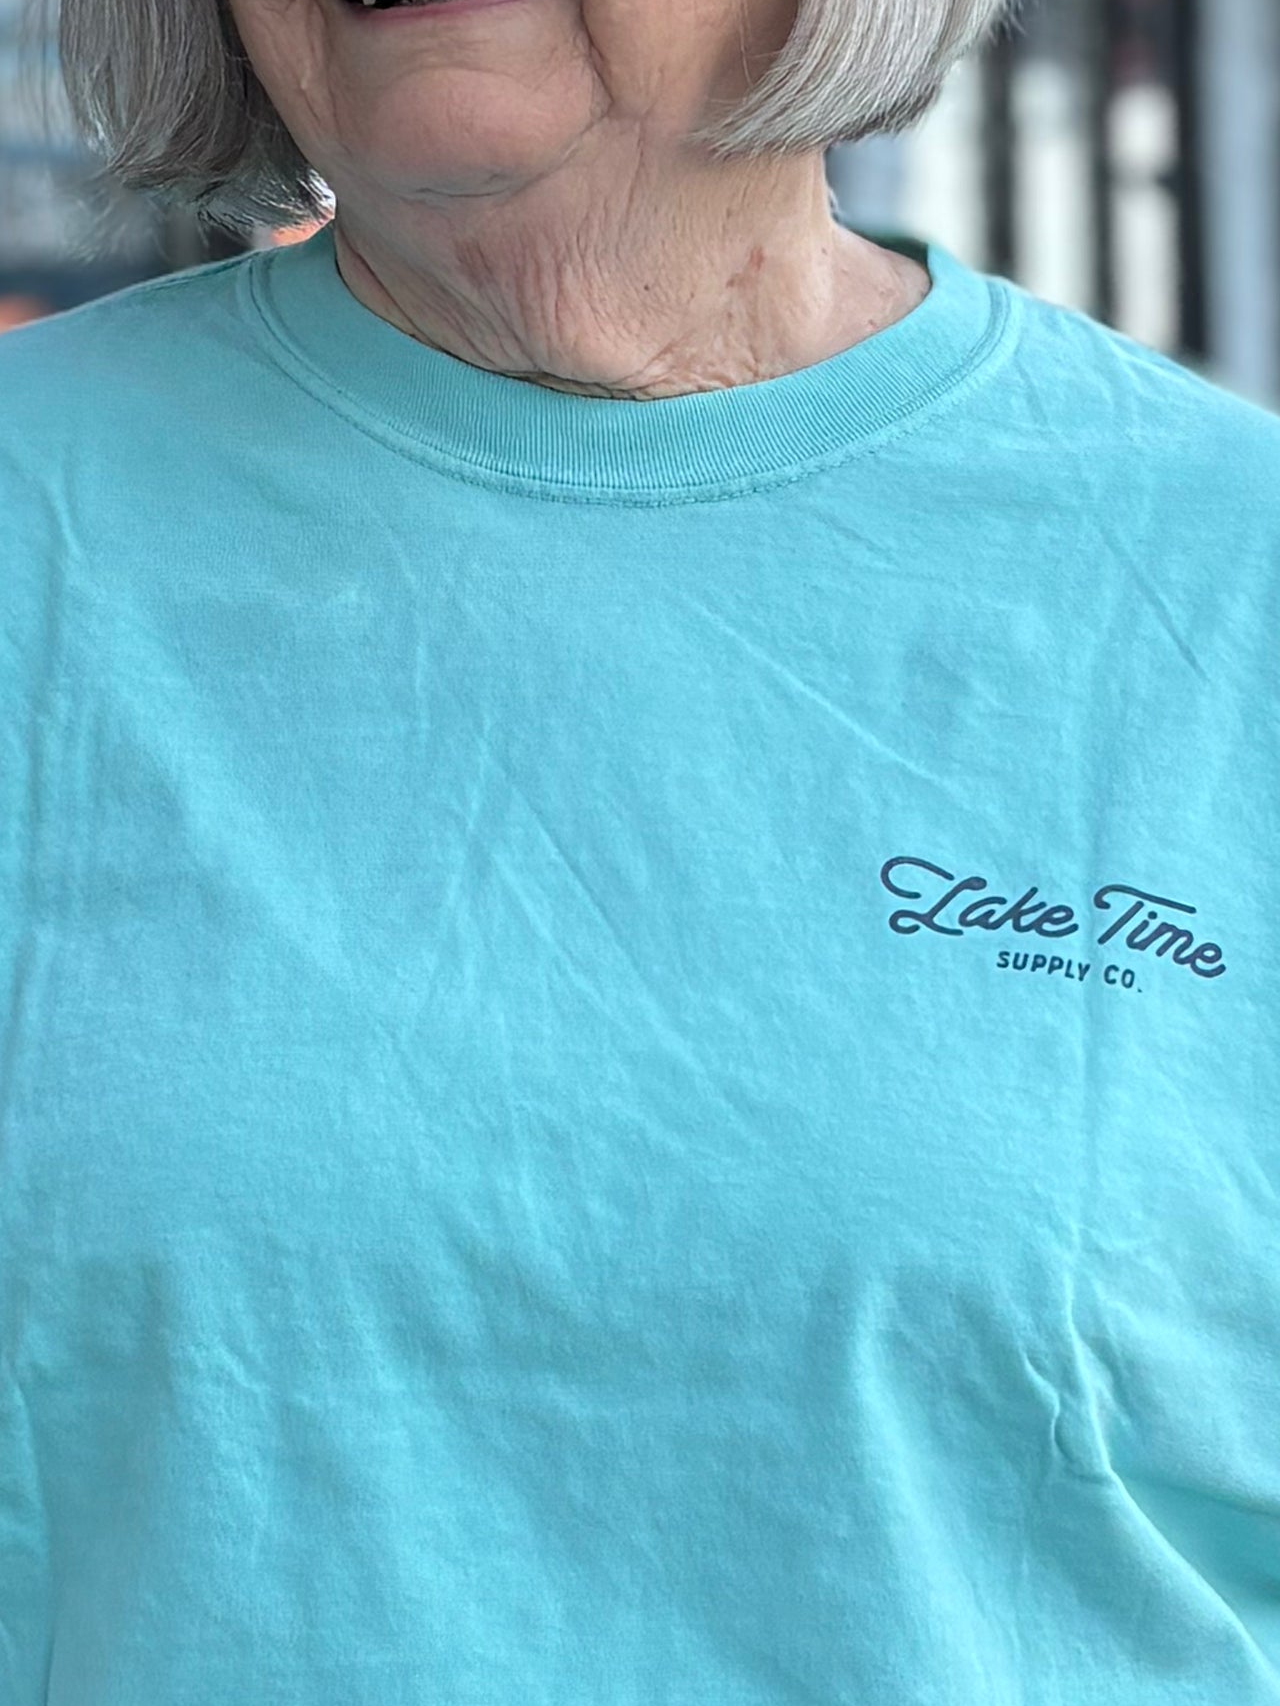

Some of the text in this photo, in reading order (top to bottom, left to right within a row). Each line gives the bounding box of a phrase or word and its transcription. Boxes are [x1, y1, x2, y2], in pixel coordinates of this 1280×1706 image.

[880, 856, 1226, 978] Lake Time
[996, 950, 1143, 993] SUPPLY CO.
